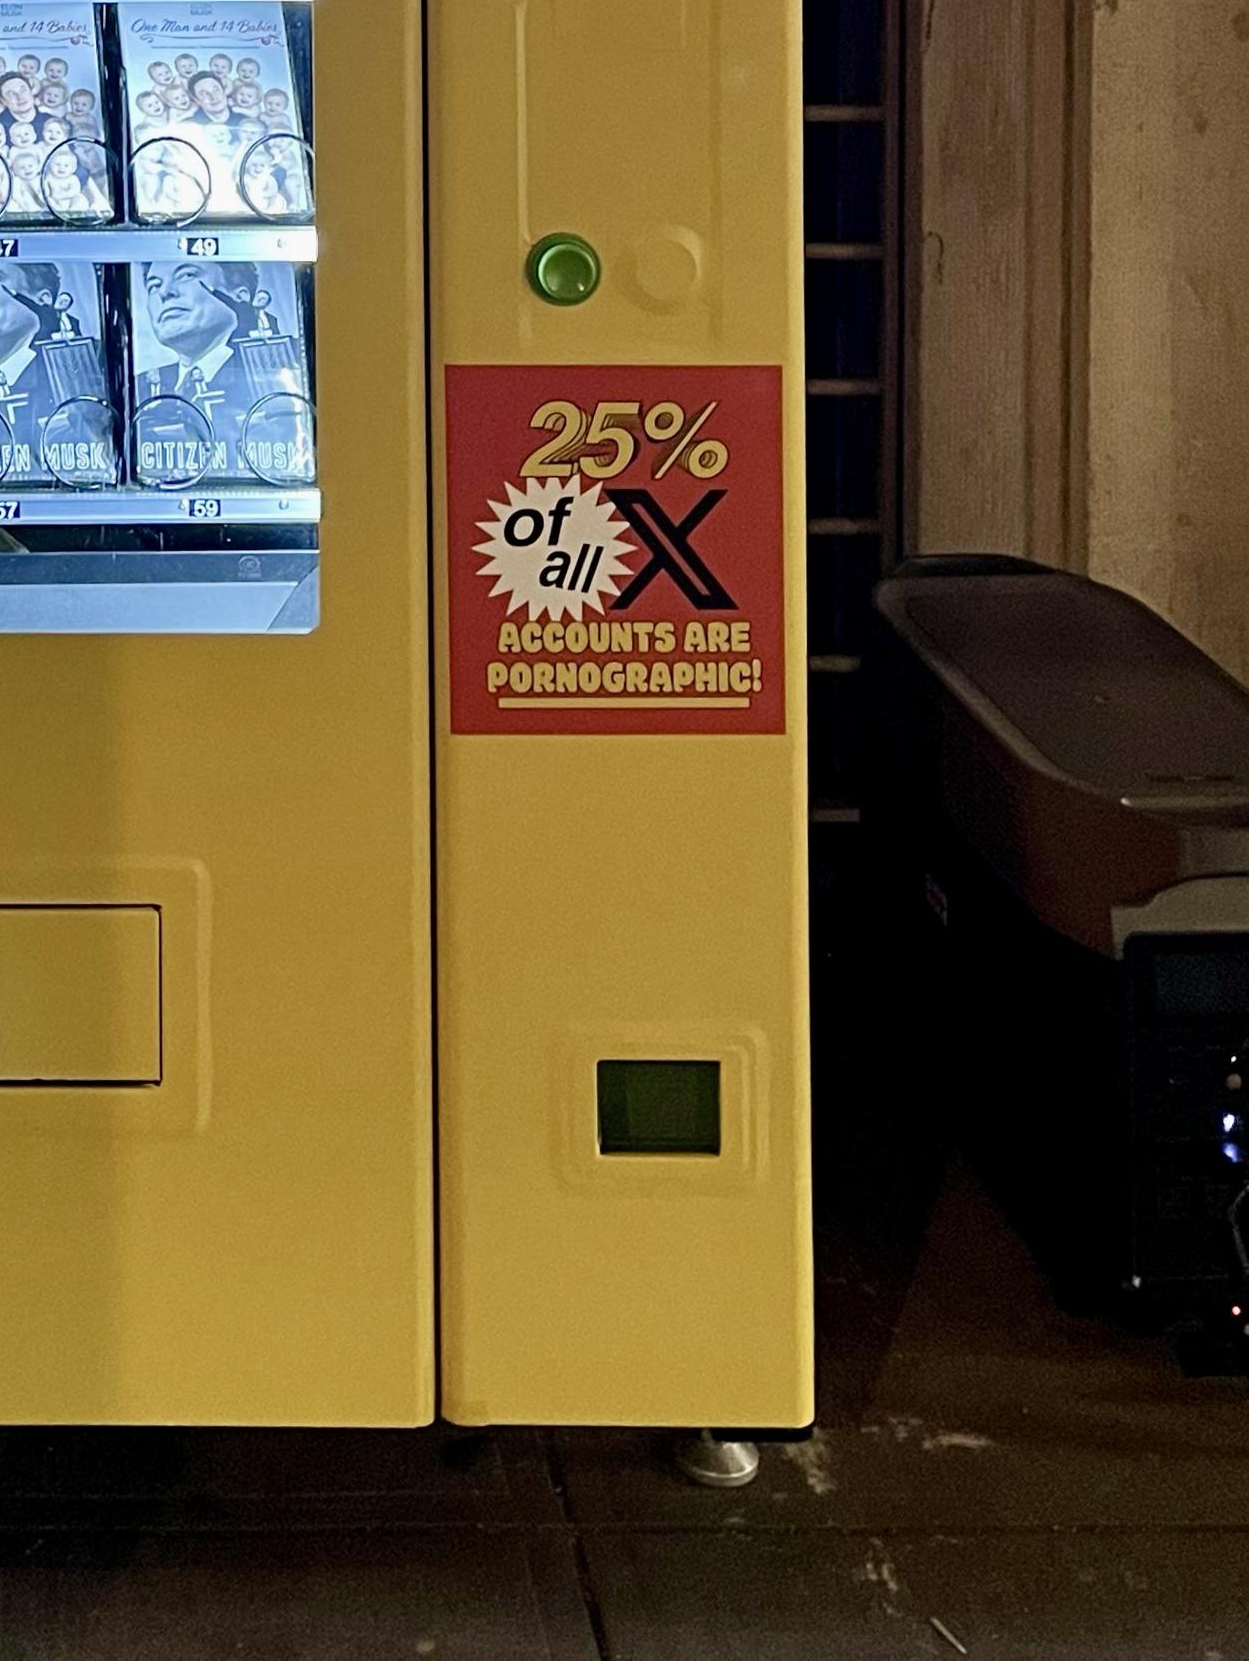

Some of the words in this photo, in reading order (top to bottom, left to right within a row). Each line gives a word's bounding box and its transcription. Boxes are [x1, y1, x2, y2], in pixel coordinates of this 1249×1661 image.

[2, 21, 28, 33] and
[30, 21, 43, 32] 14
[46, 20, 87, 33] Babies
[131, 18, 158, 33] One
[160, 18, 189, 32] Man
[193, 20, 218, 32] and
[220, 20, 234, 32] 14
[236, 19, 277, 33] Babies
[192, 238, 217, 255] 49
[41, 442, 107, 470] MUSK
[520, 400, 729, 480] 25%
[194, 500, 218, 517] 59
[503, 496, 574, 547] of
[603, 488, 740, 610] X
[539, 543, 604, 593] all
[498, 621, 676, 653] ACCOUNTS
[683, 621, 751, 653] ARE
[487, 659, 762, 693] PORNOGRAPHIC!
